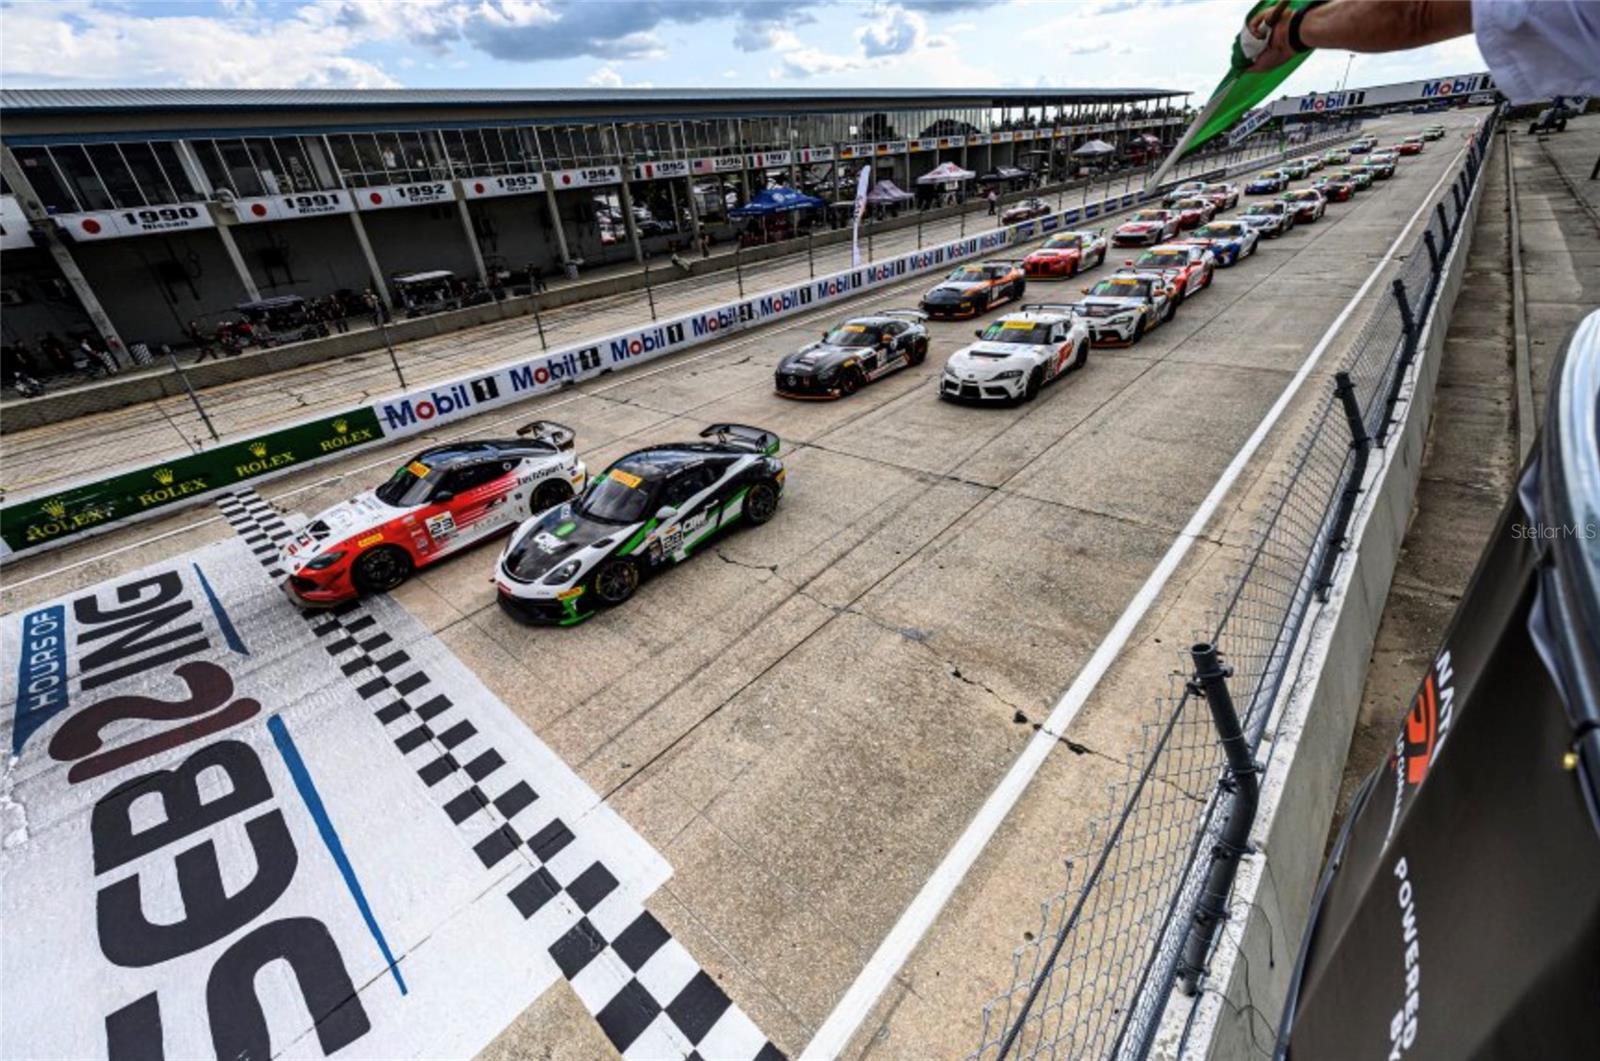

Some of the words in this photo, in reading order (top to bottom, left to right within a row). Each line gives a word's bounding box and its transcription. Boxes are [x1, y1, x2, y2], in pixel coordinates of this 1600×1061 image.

[1421, 75, 1478, 98] Mobil
[1300, 91, 1346, 113] Mobil
[581, 168, 616, 180] 1994
[655, 161, 685, 172] 1995
[396, 183, 447, 198] 1992
[496, 175, 538, 188] 1993
[284, 194, 341, 209] 1991
[122, 207, 199, 225] 1990
[910, 248, 934, 271] Mobil
[867, 263, 895, 282] Mobil
[817, 276, 850, 299] Mobil
[760, 290, 799, 317] Mobil
[691, 306, 737, 336] Mobil
[610, 329, 665, 362] Mobil
[509, 354, 578, 392] Mobil
[384, 384, 471, 430] Mobil
[320, 428, 373, 452] ROLEX
[235, 451, 296, 477] ROLEX
[138, 478, 208, 507] ROLEX
[26, 508, 105, 542] ROLEX
[429, 517, 455, 536] 23
[30, 611, 58, 636] OF
[28, 635, 60, 711] HOURS
[1394, 856, 1420, 1050] POWERED
